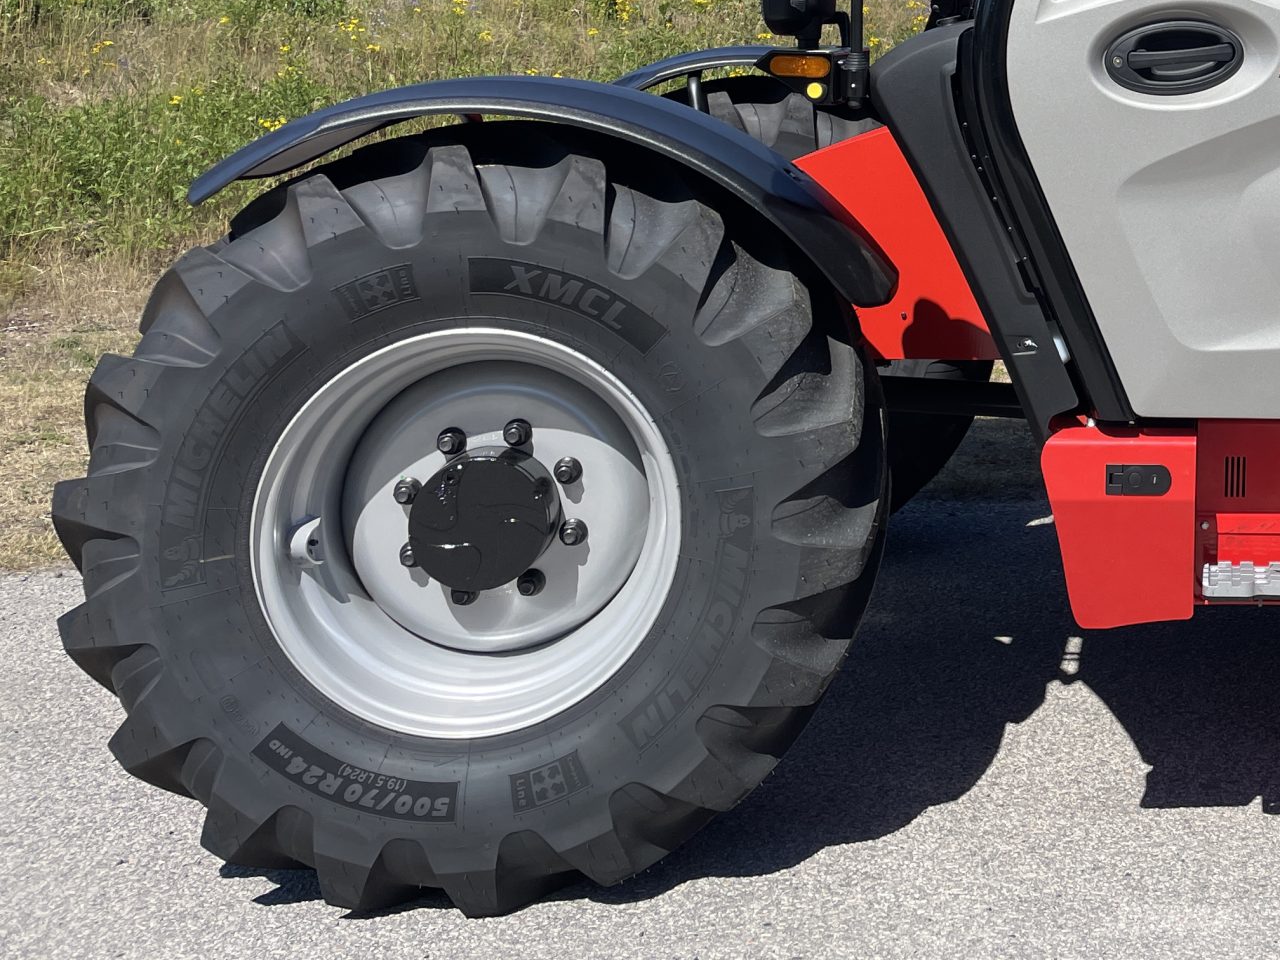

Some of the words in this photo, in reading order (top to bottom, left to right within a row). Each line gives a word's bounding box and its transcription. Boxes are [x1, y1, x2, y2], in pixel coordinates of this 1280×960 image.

[504, 265, 628, 330] XMCL
[164, 324, 300, 531] MICHELIN
[630, 542, 750, 748] MICHELIN
[267, 739, 290, 762] IND
[284, 756, 343, 792] R24
[342, 783, 450, 817] 500/70
